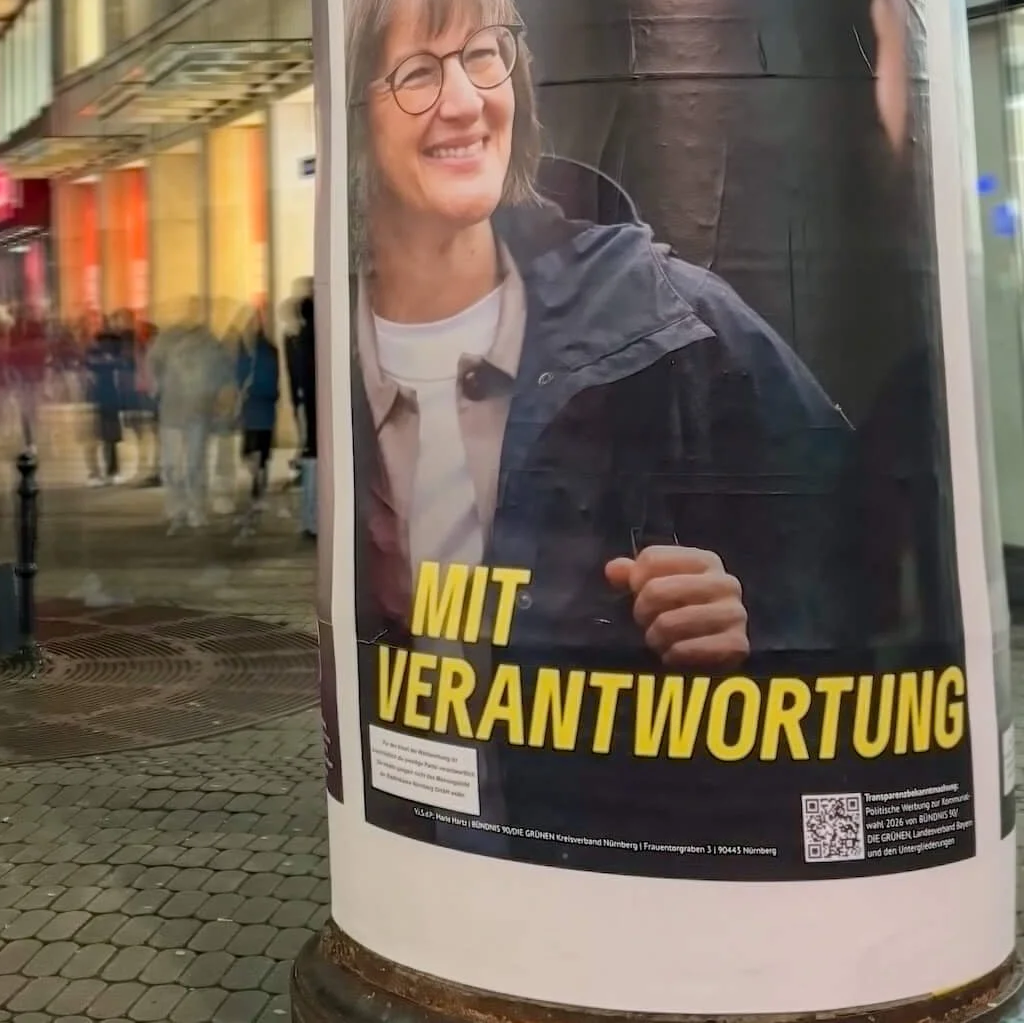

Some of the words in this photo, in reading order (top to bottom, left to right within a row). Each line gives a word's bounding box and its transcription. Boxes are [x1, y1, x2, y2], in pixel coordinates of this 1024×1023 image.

[410, 560, 532, 647] MIT
[379, 644, 965, 762] VERANTWORTUNG
[865, 805, 900, 816] Politische
[901, 801, 930, 812] Werbung
[931, 800, 940, 808] zur
[866, 820, 885, 830] wahl
[886, 817, 904, 829] 2026
[905, 817, 917, 826] von
[918, 811, 948, 824] BÜNDNIS
[525, 829, 555, 841] GRÜNEN
[556, 833, 602, 846] Kreisverband
[603, 838, 638, 851] Nürnberg
[643, 841, 705, 854] Frauentorgraben
[743, 846, 777, 857] Nürnberg
[867, 833, 880, 844] DIE
[913, 823, 955, 838] Landesverband
[867, 848, 882, 858] und
[883, 847, 897, 856] den
[898, 837, 955, 854] Untergliederungen
